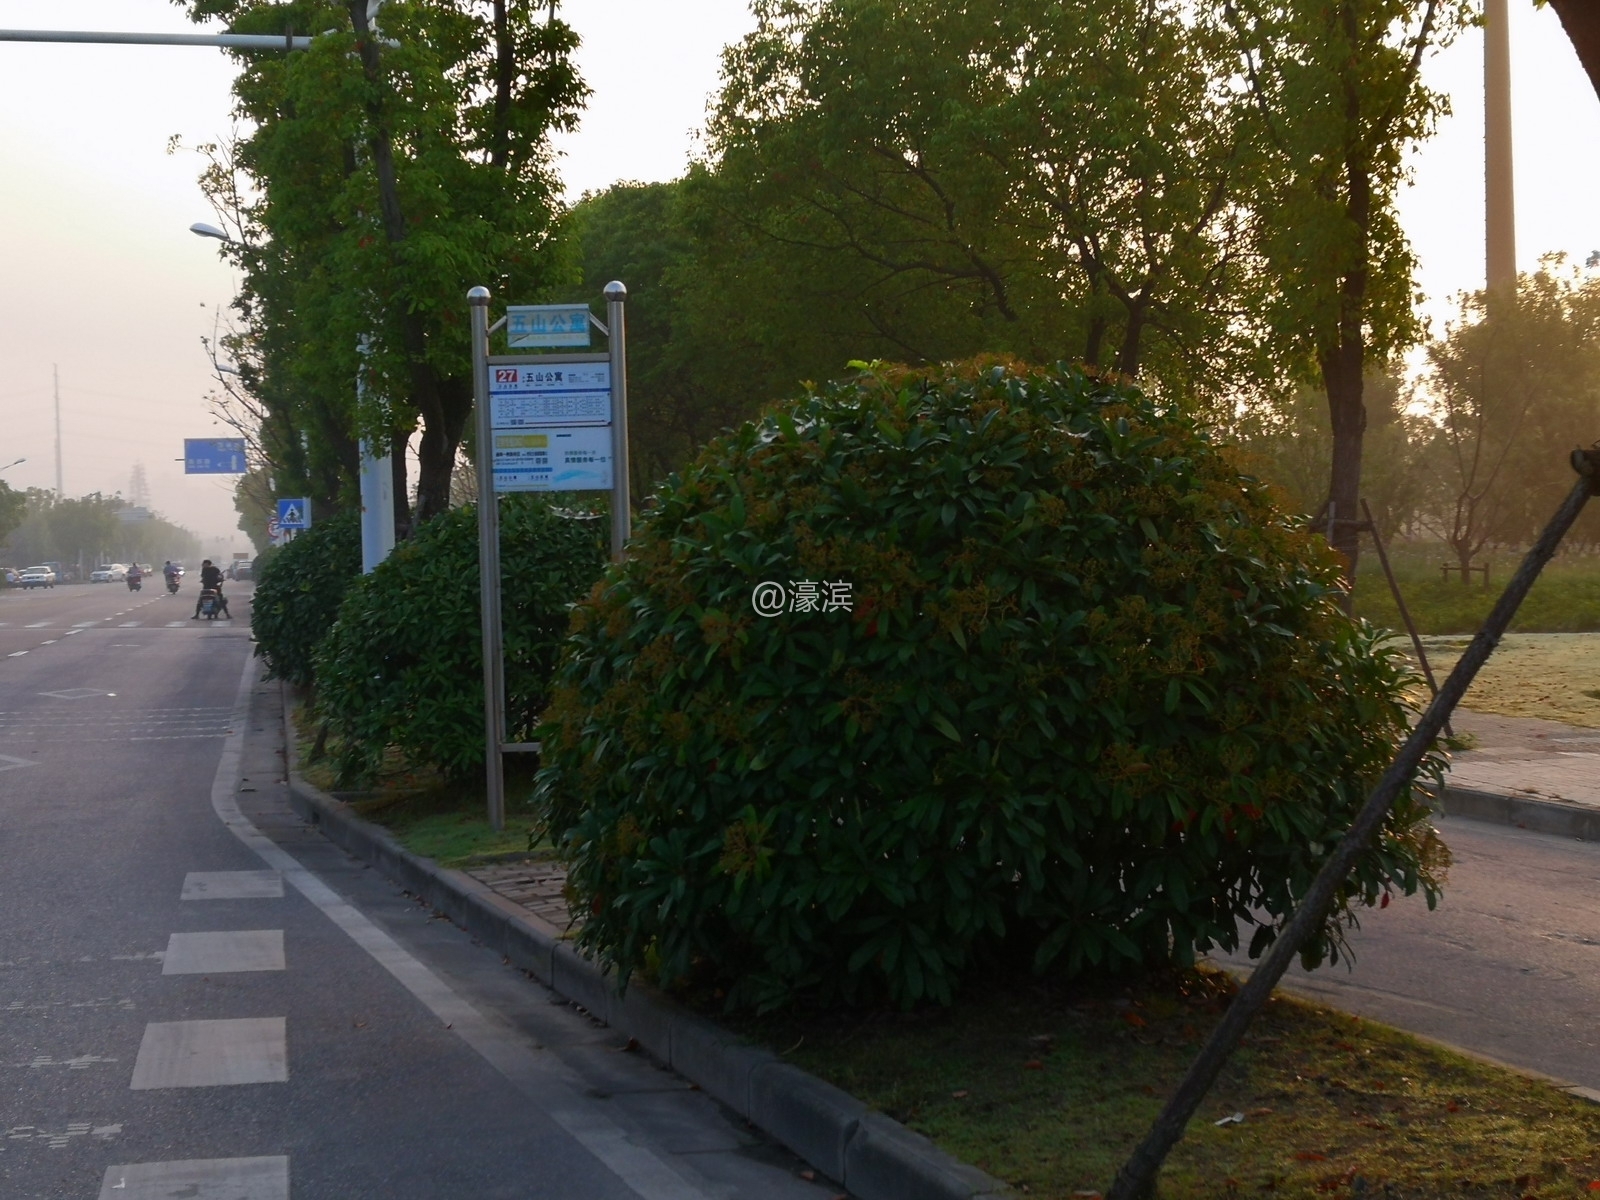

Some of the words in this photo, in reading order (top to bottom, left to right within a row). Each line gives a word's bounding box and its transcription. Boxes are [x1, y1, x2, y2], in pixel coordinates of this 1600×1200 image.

[510, 312, 586, 333] 五山公寓
[497, 370, 515, 382] 27
[526, 371, 563, 383] 五山公寓
